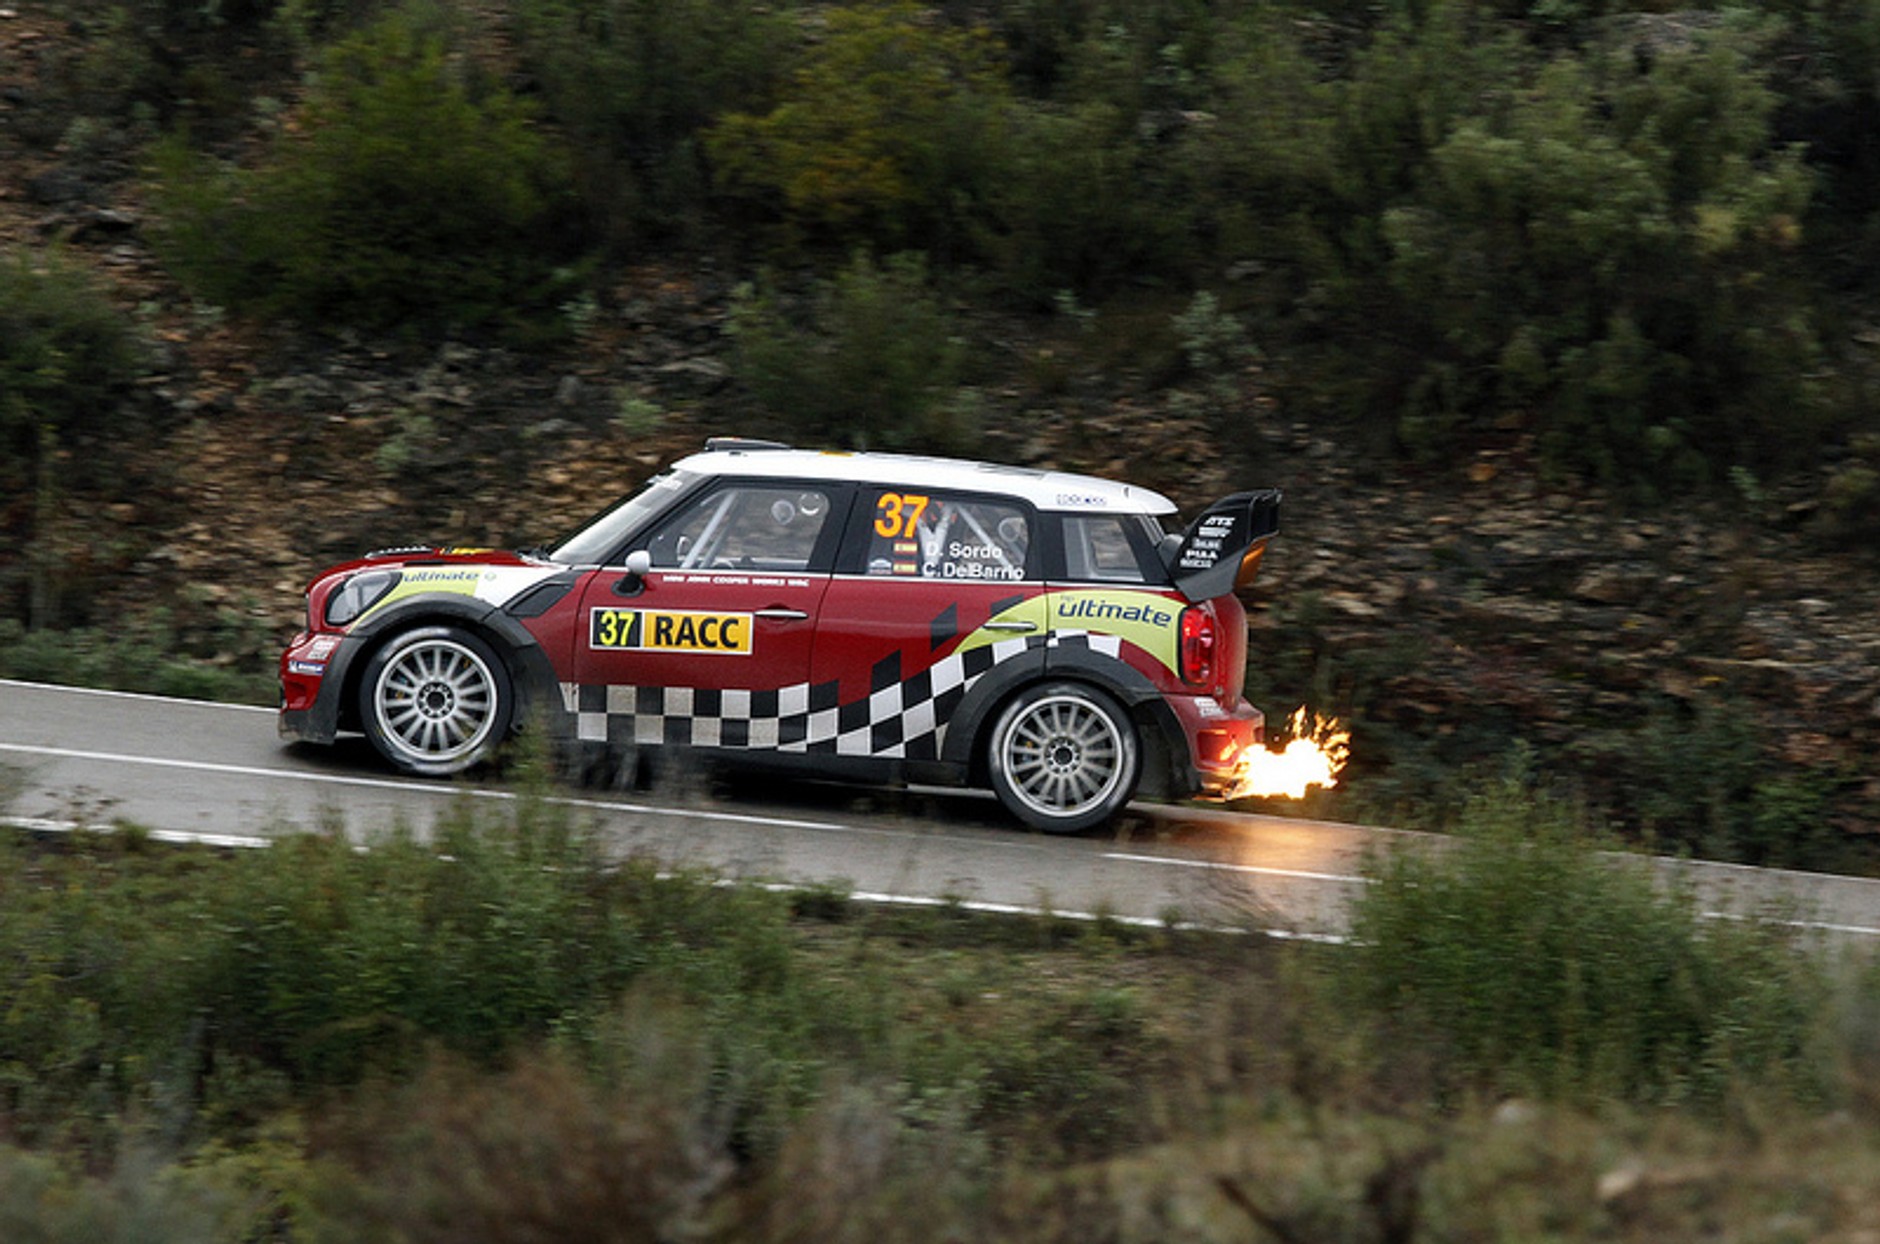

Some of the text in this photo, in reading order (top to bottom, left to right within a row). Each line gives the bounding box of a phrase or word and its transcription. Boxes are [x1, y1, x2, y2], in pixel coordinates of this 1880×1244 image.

[873, 491, 929, 538] 37
[949, 541, 1003, 559] Sordo
[600, 610, 739, 649] 37 RACC
[1058, 599, 1172, 628] ultimate
